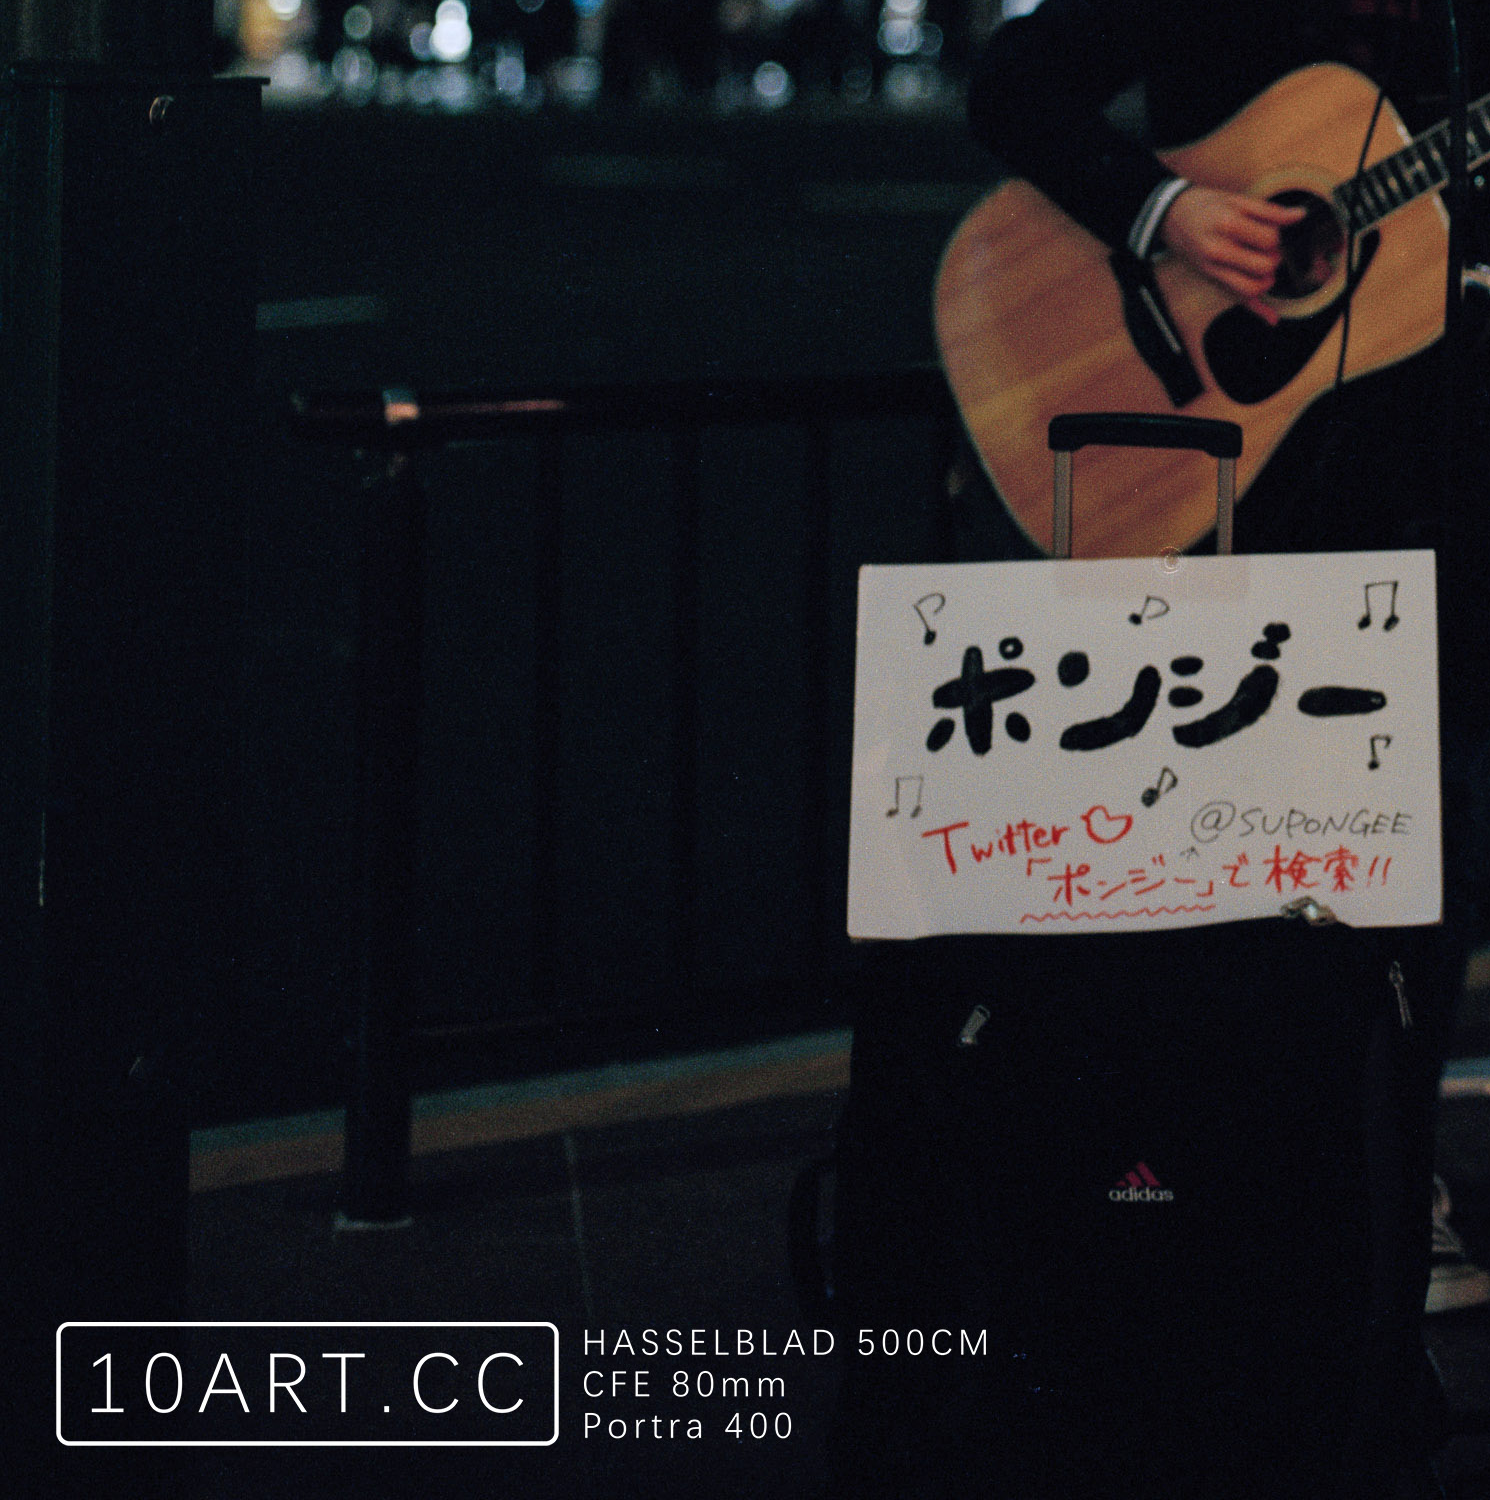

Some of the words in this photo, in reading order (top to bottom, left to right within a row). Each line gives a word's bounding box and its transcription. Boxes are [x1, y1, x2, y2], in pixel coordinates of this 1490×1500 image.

[925, 622, 1388, 755] ポンジー
[921, 819, 1071, 875] Twitter
[1190, 801, 1412, 844] @SUPONGEE
[1108, 1186, 1175, 1203] adidas
